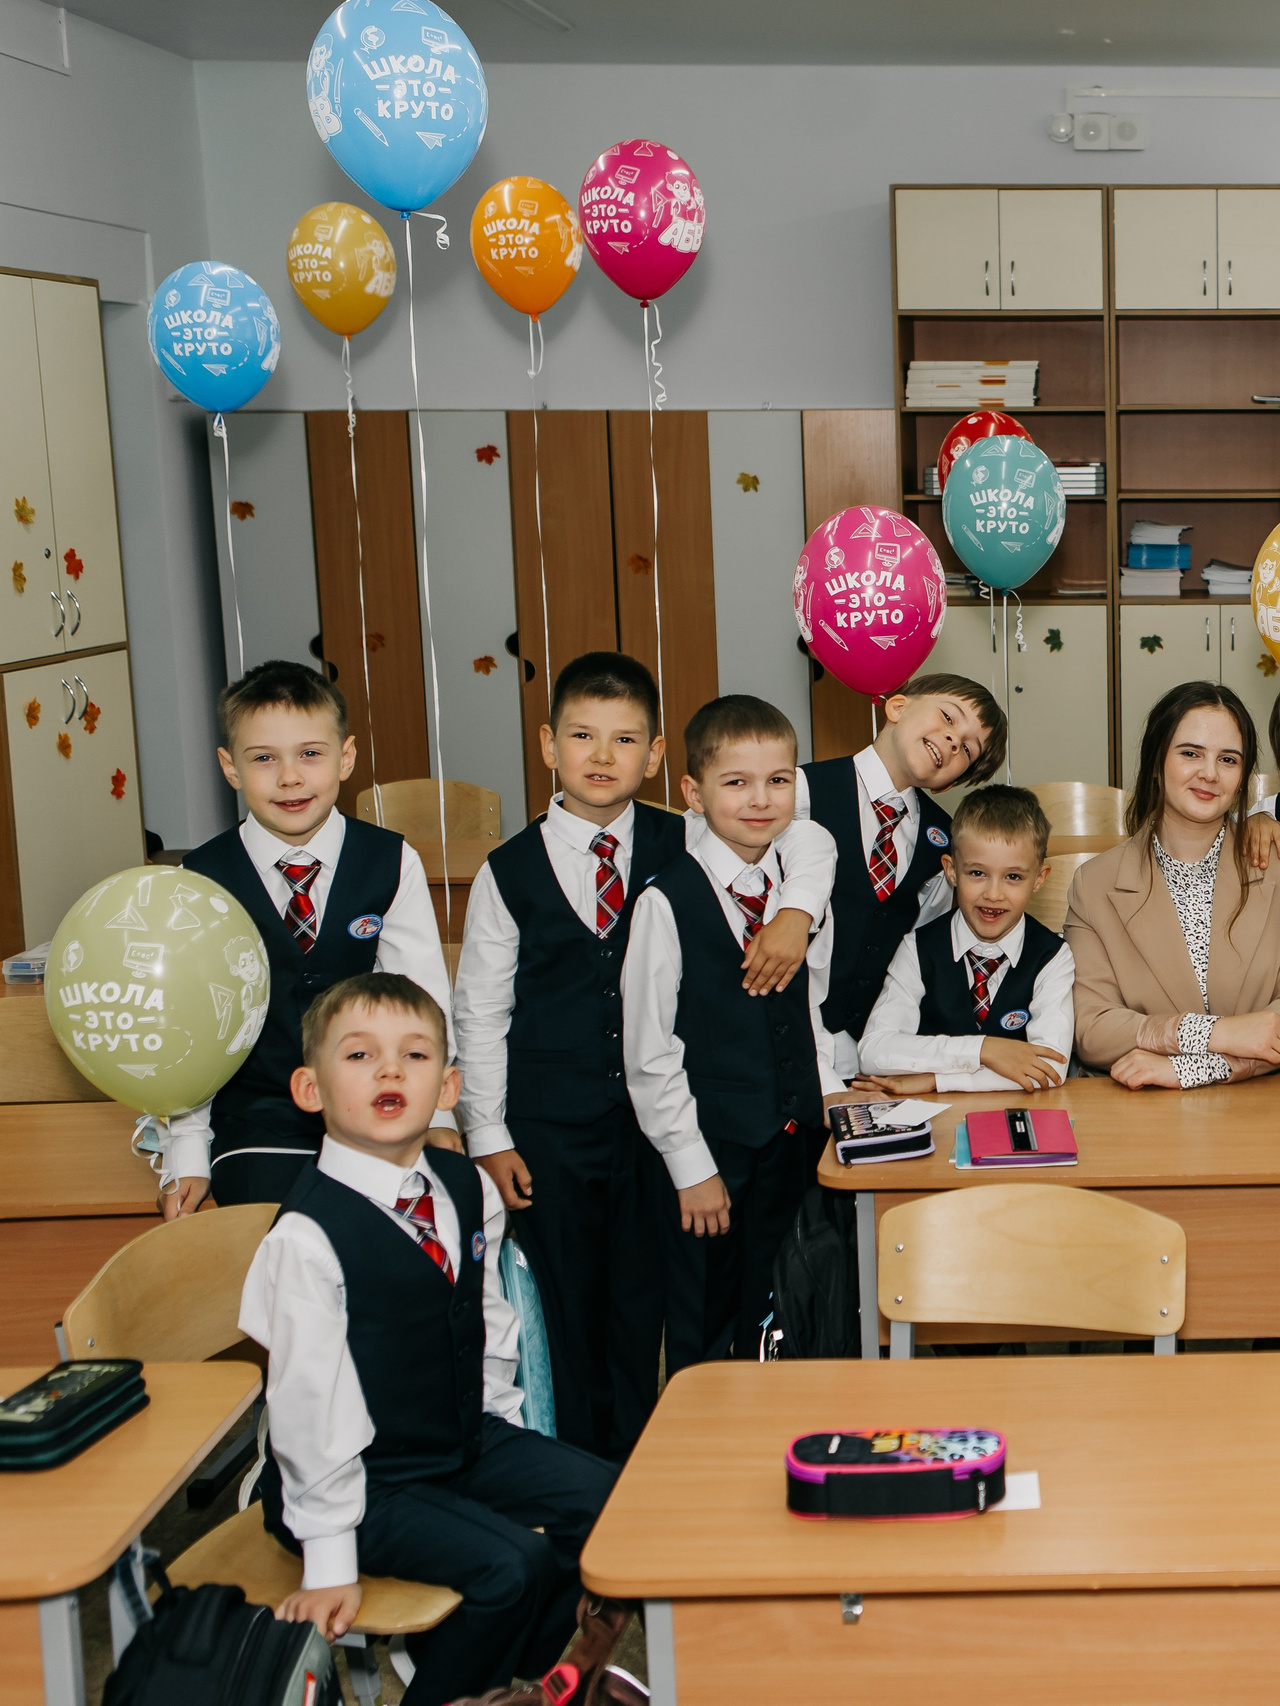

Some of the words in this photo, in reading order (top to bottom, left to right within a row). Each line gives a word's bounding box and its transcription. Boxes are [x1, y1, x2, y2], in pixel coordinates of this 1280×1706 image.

[362, 55, 457, 84] ШКОЛА
[377, 99, 454, 121] КРУТО
[581, 186, 635, 207] ШКОЛА
[483, 217, 540, 237] ШКОЛА
[585, 219, 632, 234] КРУТО
[288, 243, 333, 260] ШКОЛА
[490, 246, 539, 260] КРУТО
[292, 270, 332, 283] КРУТО
[163, 308, 234, 329] ШКОЛА
[172, 342, 233, 356] КРУТО
[969, 488, 1035, 510] ШКОЛА
[976, 519, 1030, 534] КРУТО
[825, 570, 905, 596] ШКОЛА
[836, 609, 904, 628] КРУТО
[58, 981, 164, 1011] ШКОЛА
[72, 1030, 163, 1052] КРУТО
